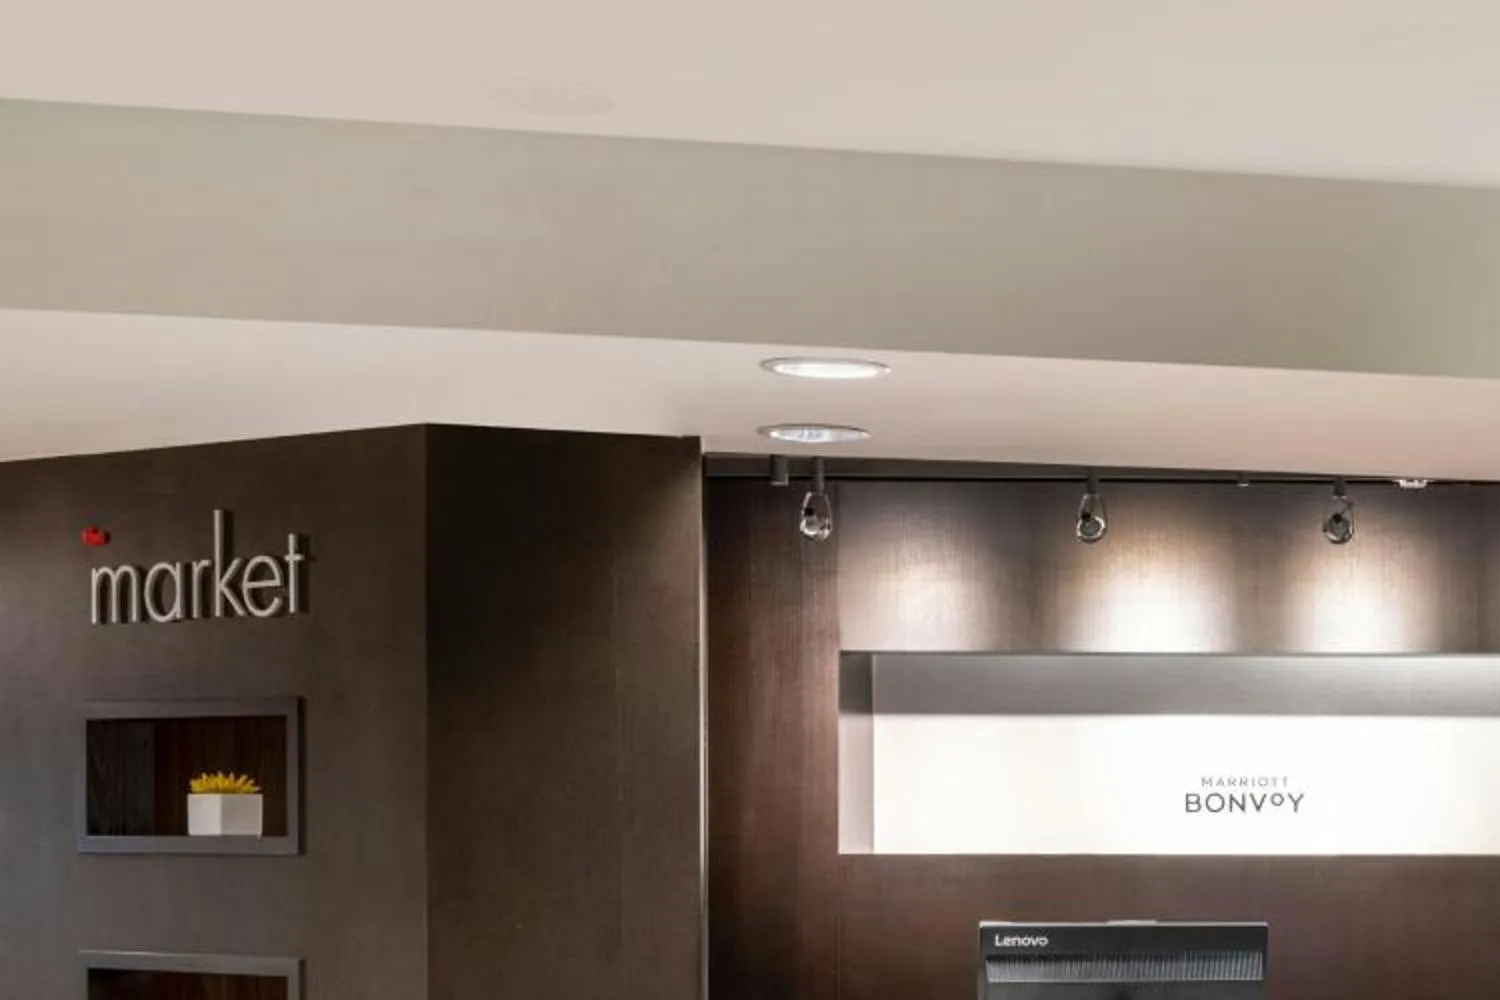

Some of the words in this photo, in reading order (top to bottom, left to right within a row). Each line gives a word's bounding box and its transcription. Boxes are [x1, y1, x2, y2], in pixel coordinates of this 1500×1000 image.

[91, 509, 305, 625] market
[1201, 776, 1288, 787] MARRIOTT
[1185, 792, 1304, 813] BONVOY
[995, 934, 1049, 947] Lenovo
